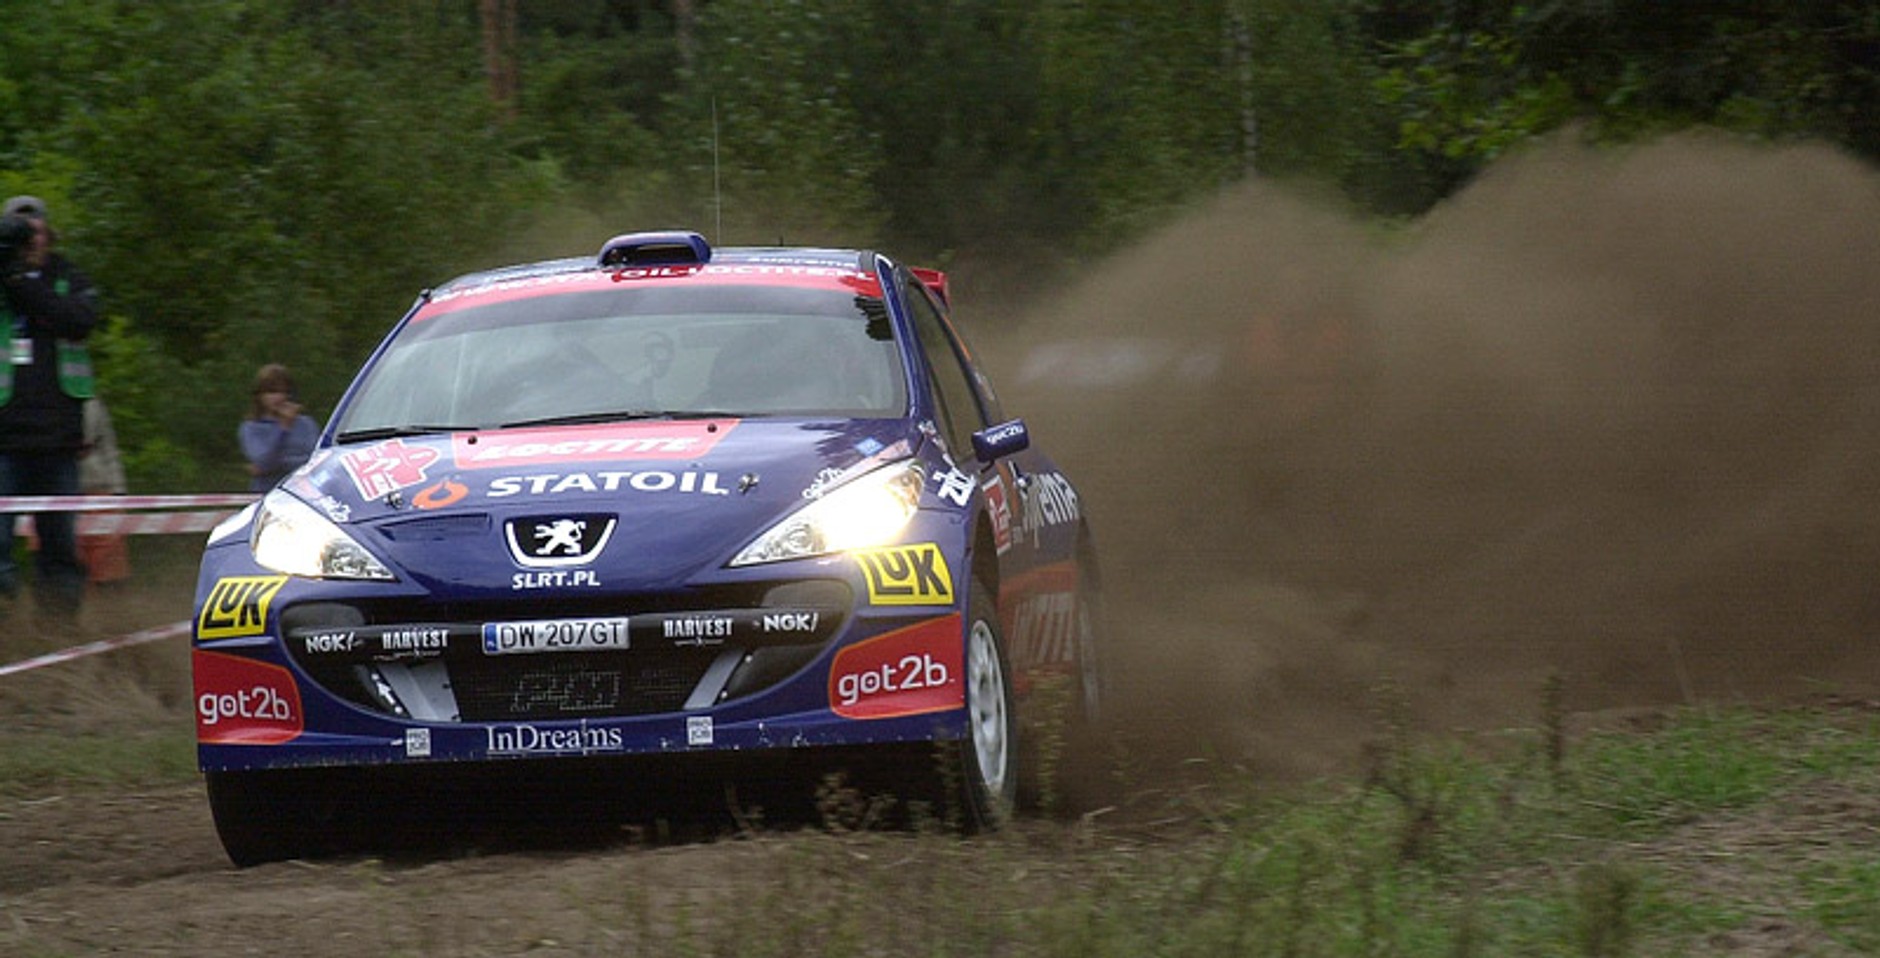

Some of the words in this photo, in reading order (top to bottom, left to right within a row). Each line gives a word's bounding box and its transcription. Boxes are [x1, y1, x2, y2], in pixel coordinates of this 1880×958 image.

[470, 437, 700, 461] LOCTITE
[486, 471, 730, 497] STATOIL
[511, 570, 601, 590] SLRT.PL
[382, 628, 449, 649] HARVEST
[500, 625, 535, 648] DW
[545, 622, 621, 647] 207GT
[664, 617, 733, 638] HARVEST
[837, 653, 948, 706] got2b
[199, 686, 290, 725] got2b
[486, 724, 623, 751] InDreams
